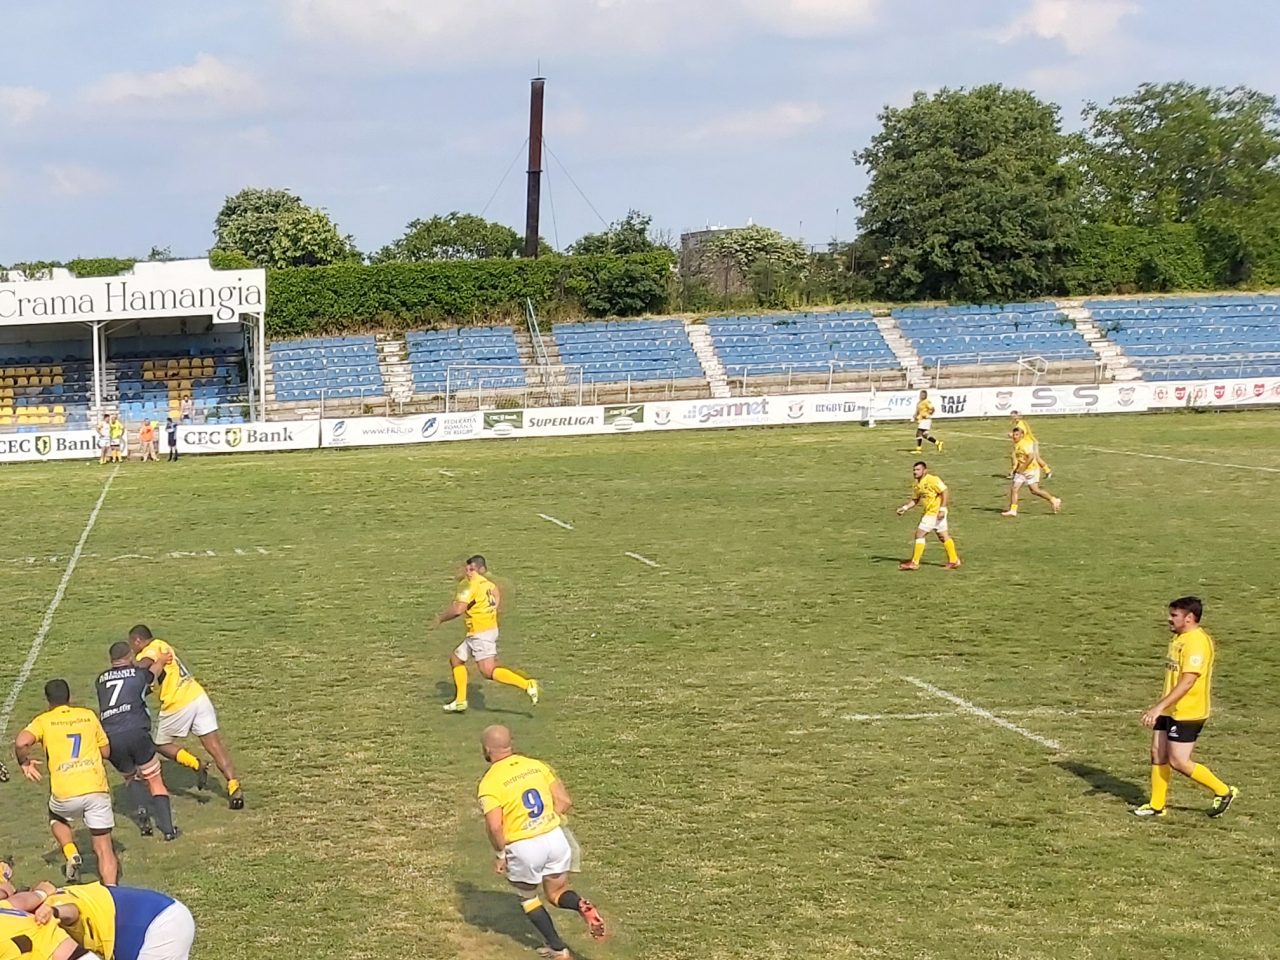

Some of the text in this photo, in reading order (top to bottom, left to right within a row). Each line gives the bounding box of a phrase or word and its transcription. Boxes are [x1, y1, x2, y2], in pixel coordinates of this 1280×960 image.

[105, 276, 262, 321] Hamangia
[56, 436, 101, 452] Bank
[183, 427, 294, 445] CEC Bank
[105, 679, 124, 707] 7
[66, 733, 82, 758] 7
[522, 788, 544, 818] 9
